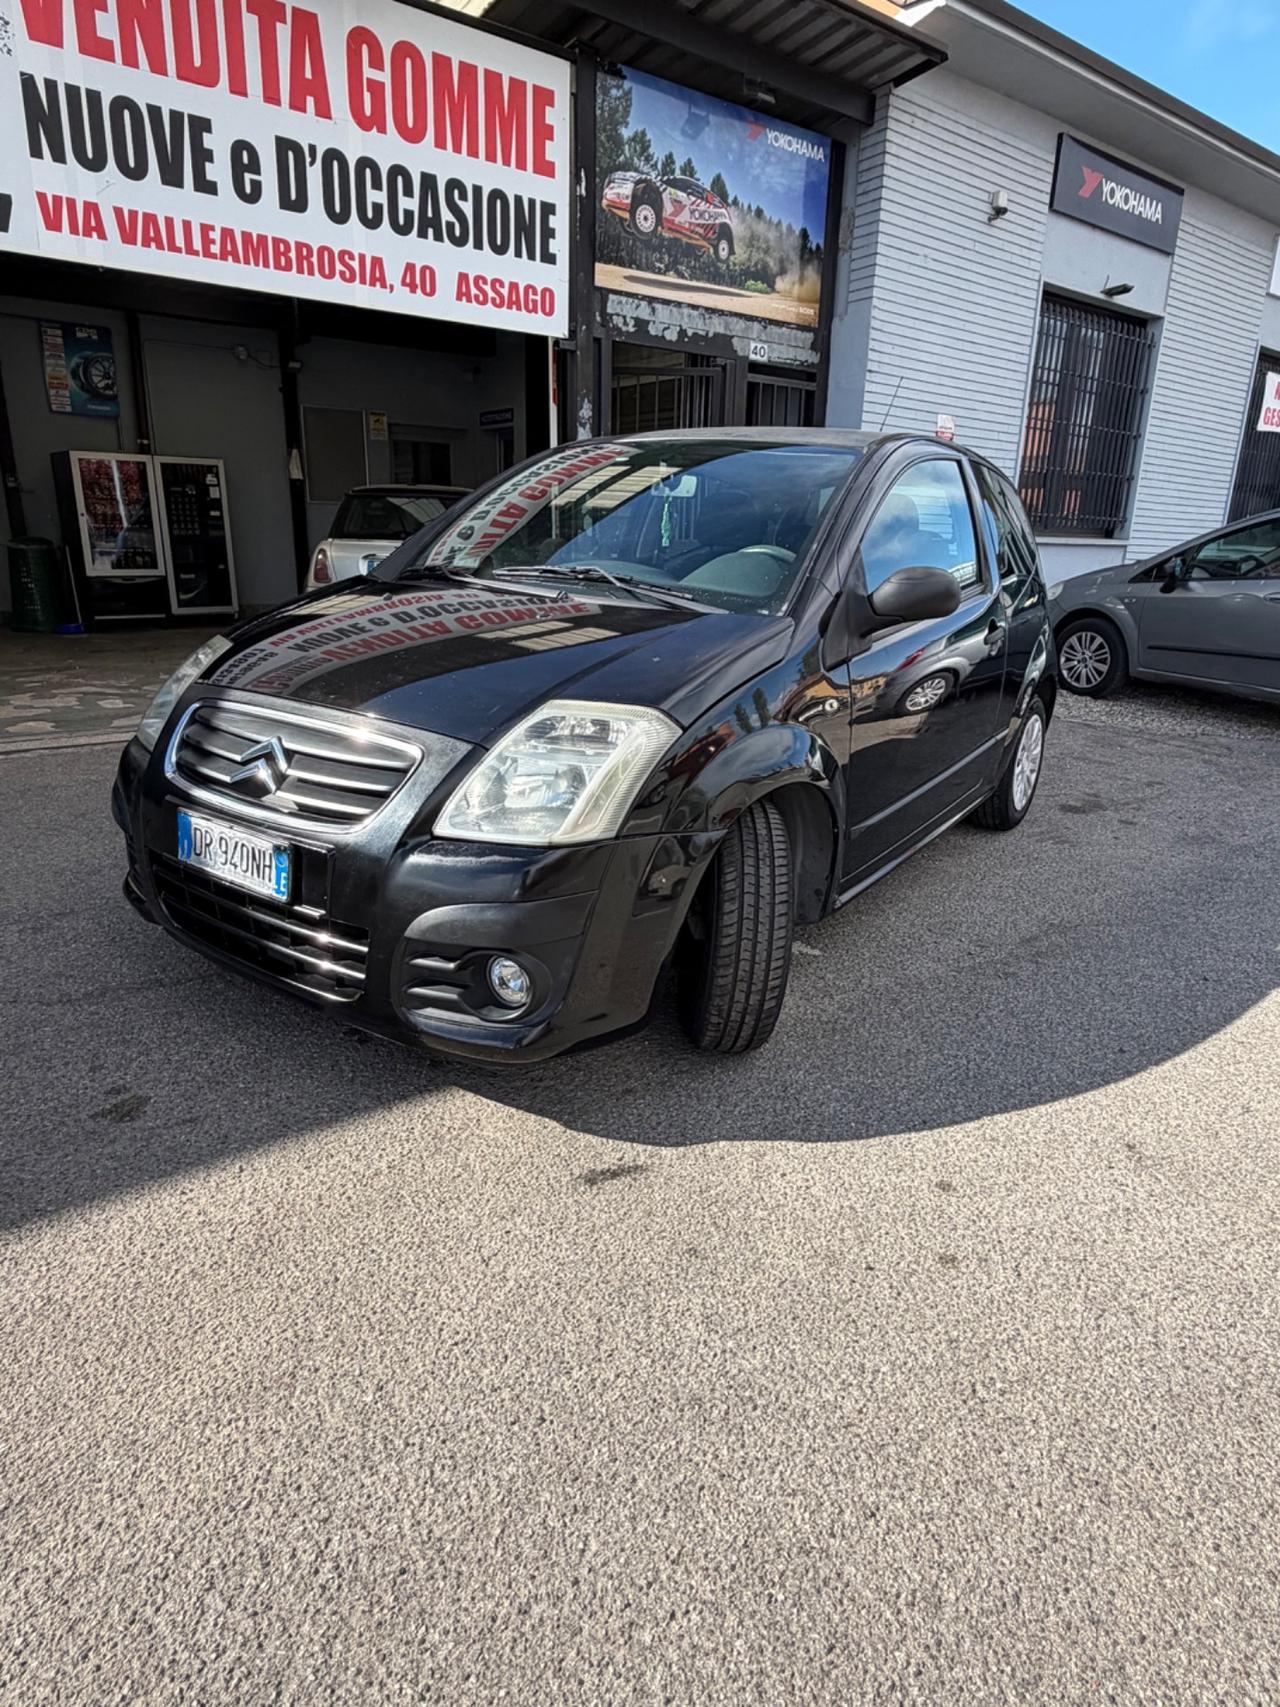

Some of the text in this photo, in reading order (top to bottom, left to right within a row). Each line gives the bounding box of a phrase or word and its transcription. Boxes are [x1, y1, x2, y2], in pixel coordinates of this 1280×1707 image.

[345, 26, 557, 179] GOMME
[19, 71, 558, 266] NUOVE e D'OCCASIONE
[766, 128, 825, 162] YOKOHAMA
[1101, 177, 1163, 225] YOKOHAMA
[35, 191, 108, 241] VIA
[113, 206, 395, 294] VALLEAMBROSIA,
[400, 262, 437, 298] 40
[455, 271, 556, 318] ASSAGO
[751, 345, 767, 358] 40
[193, 826, 213, 861] DR
[219, 835, 272, 884] 940NH
